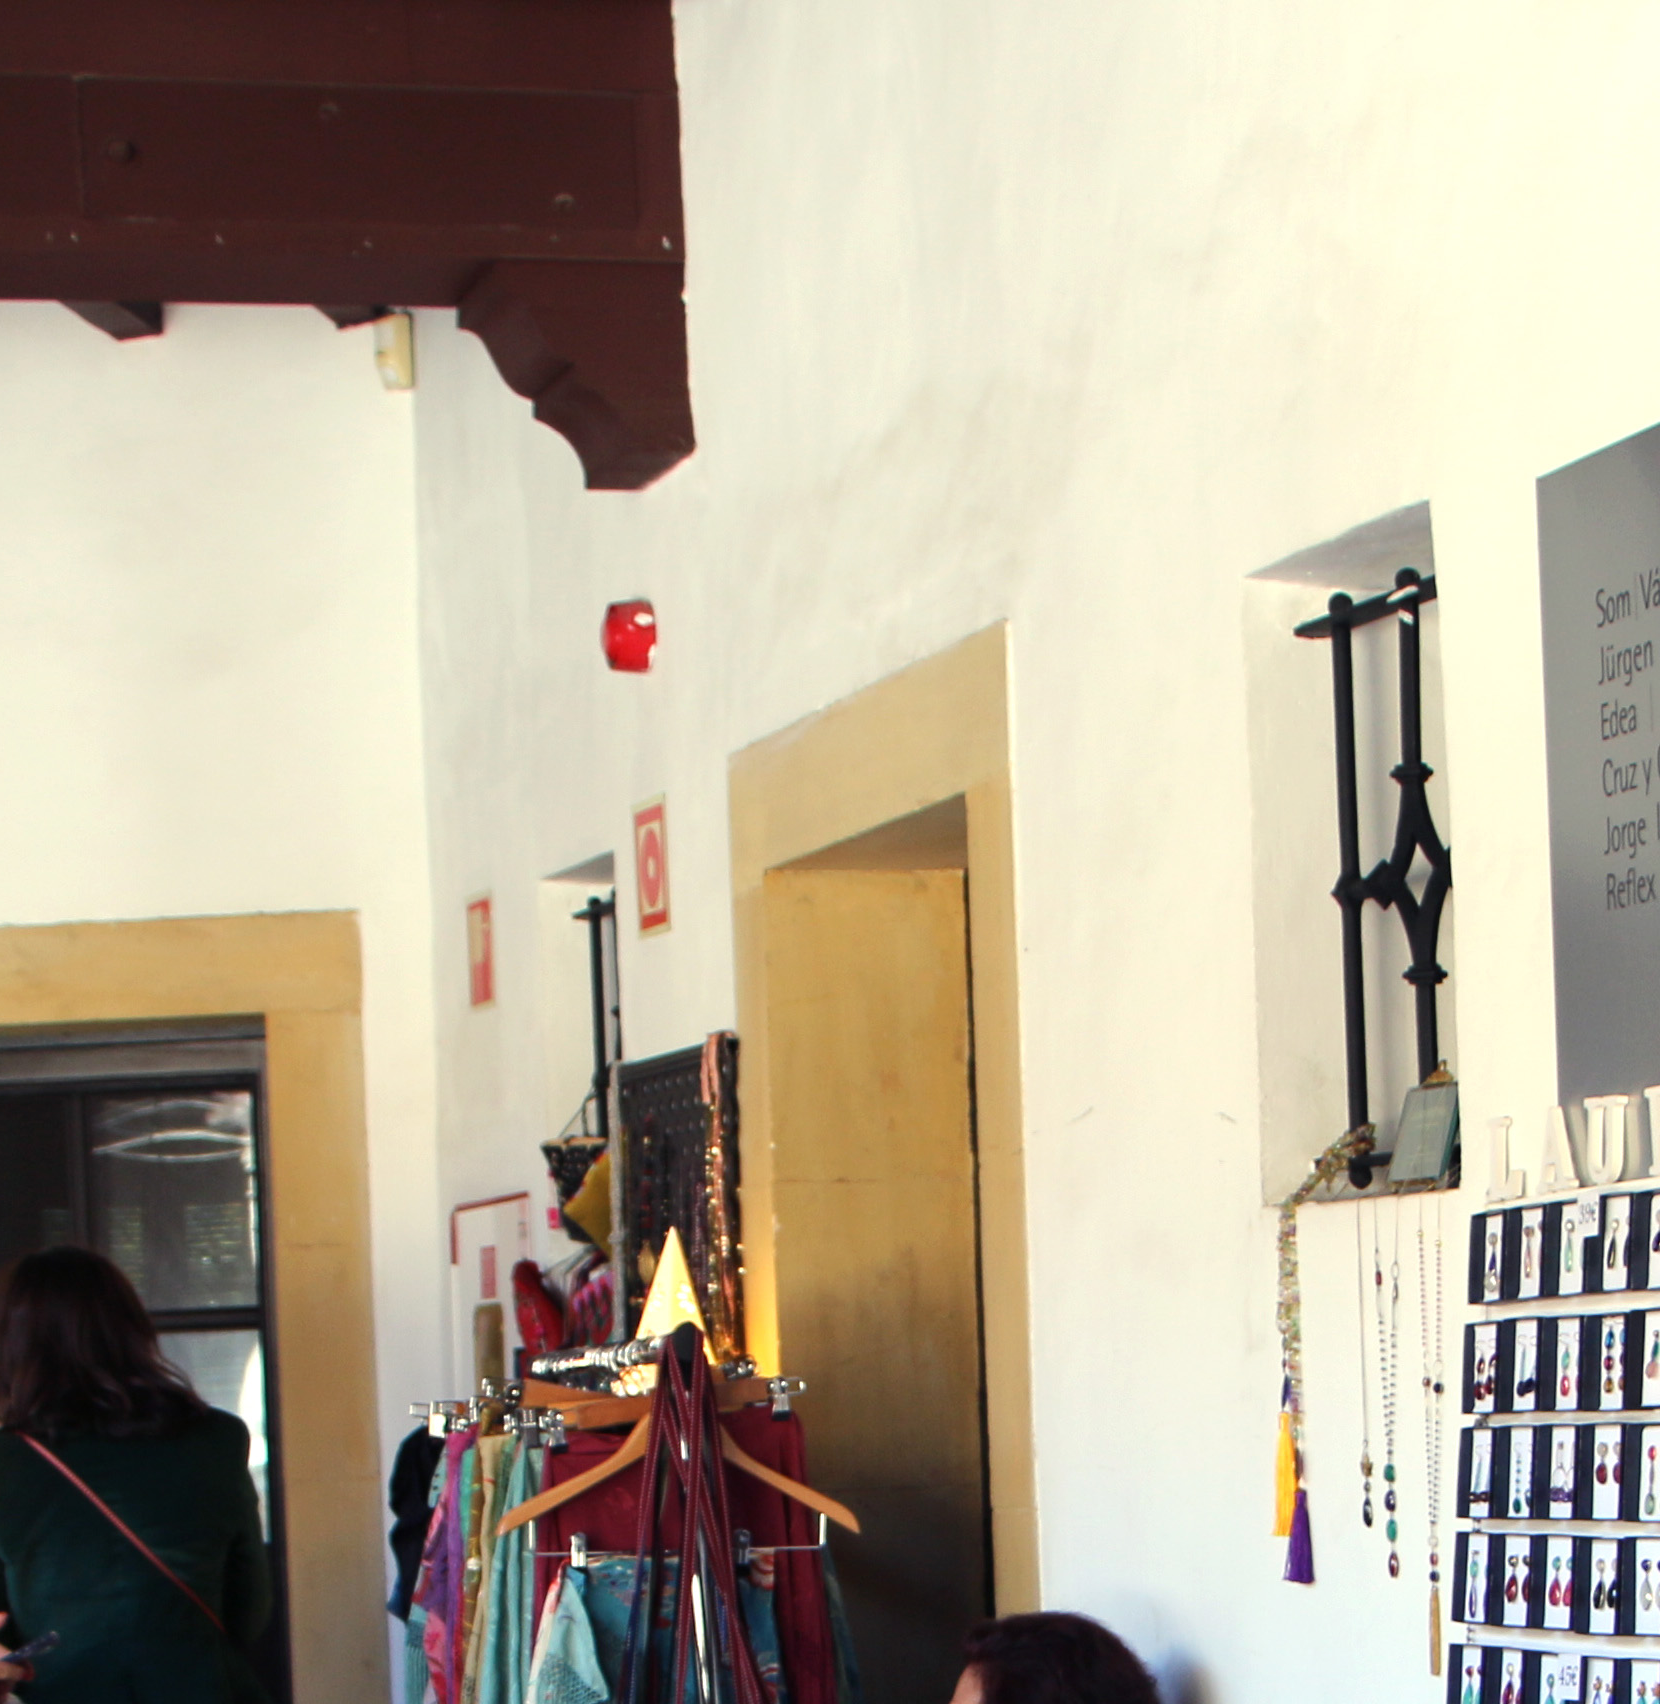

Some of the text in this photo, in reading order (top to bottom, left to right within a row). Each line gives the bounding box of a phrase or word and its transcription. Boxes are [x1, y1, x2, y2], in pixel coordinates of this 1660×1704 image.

[1596, 588, 1631, 628] Som
[1598, 639, 1654, 686] Jürgen
[1601, 701, 1637, 741] Edea
[1602, 758, 1638, 798] Cruz
[1642, 758, 1652, 795] y
[1603, 814, 1647, 859] Jorge
[1607, 866, 1657, 911] Reflex
[1580, 1202, 1599, 1224] 39€
